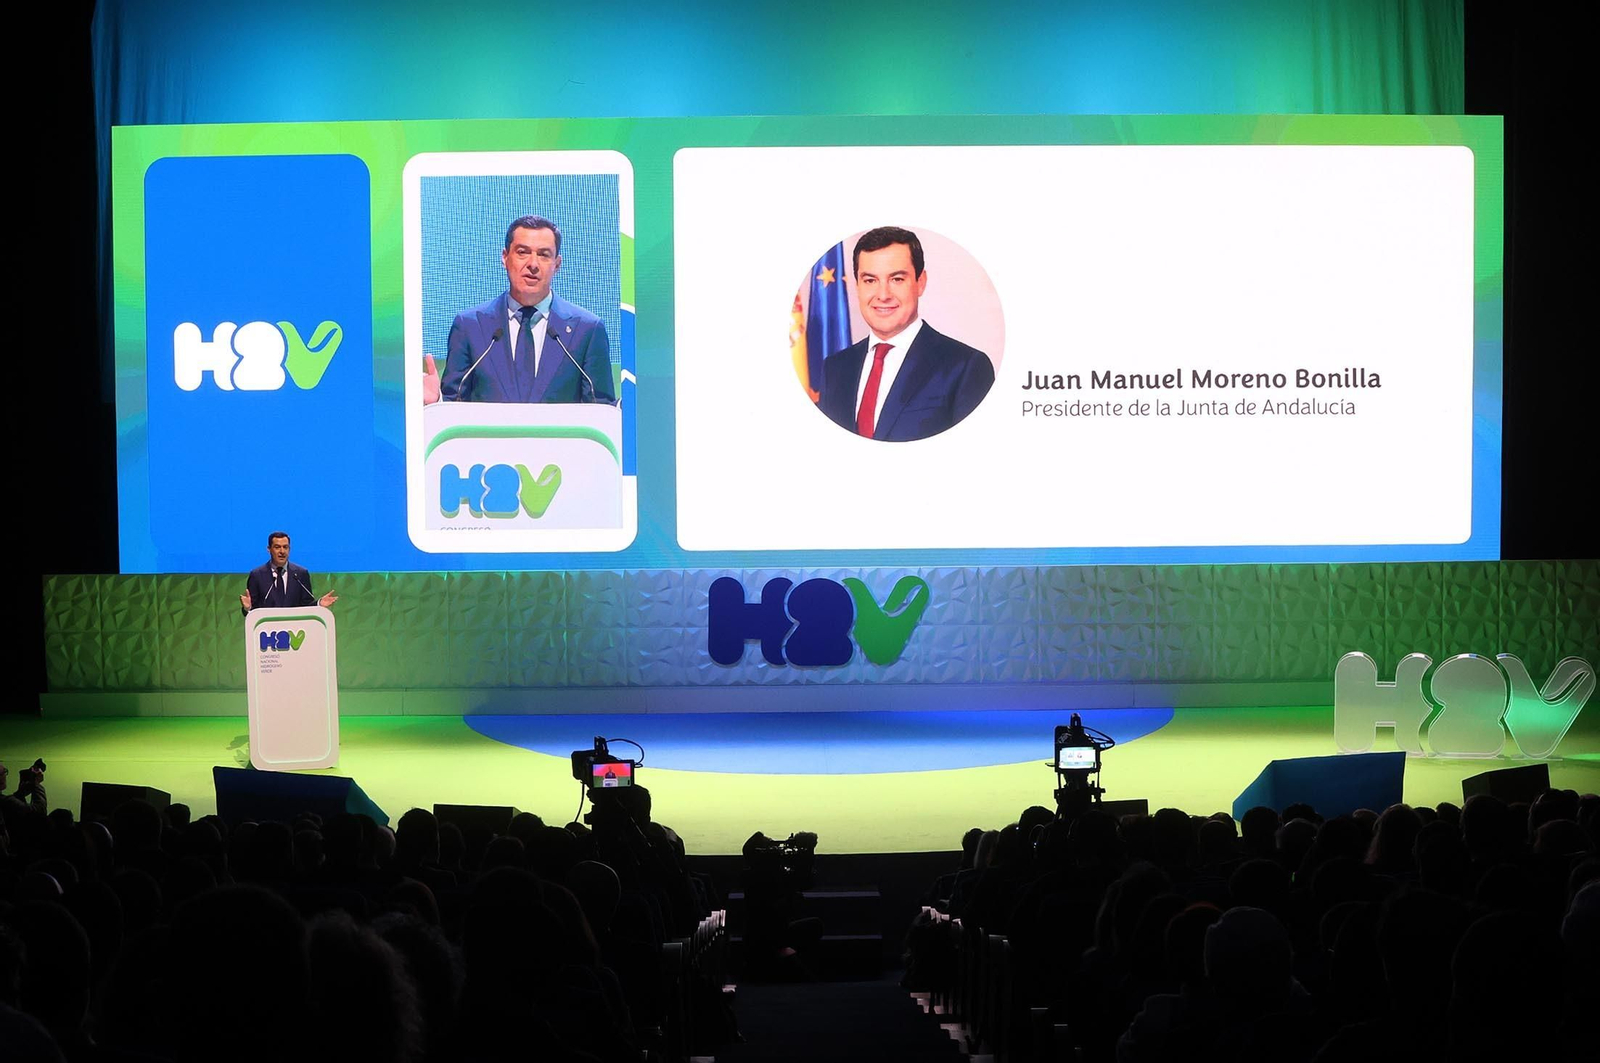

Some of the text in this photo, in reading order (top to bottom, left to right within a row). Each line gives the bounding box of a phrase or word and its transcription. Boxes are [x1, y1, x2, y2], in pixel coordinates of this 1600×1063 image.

[173, 320, 343, 392] H2V
[1022, 367, 1382, 390] Juan Manuel Moreno Bonilla
[1022, 397, 1356, 417] Presidente de la Junta de Andalucía
[440, 463, 562, 519] H2V
[259, 629, 306, 652] H2V
[707, 575, 930, 668] H2V
[1334, 651, 1597, 760] H2V
